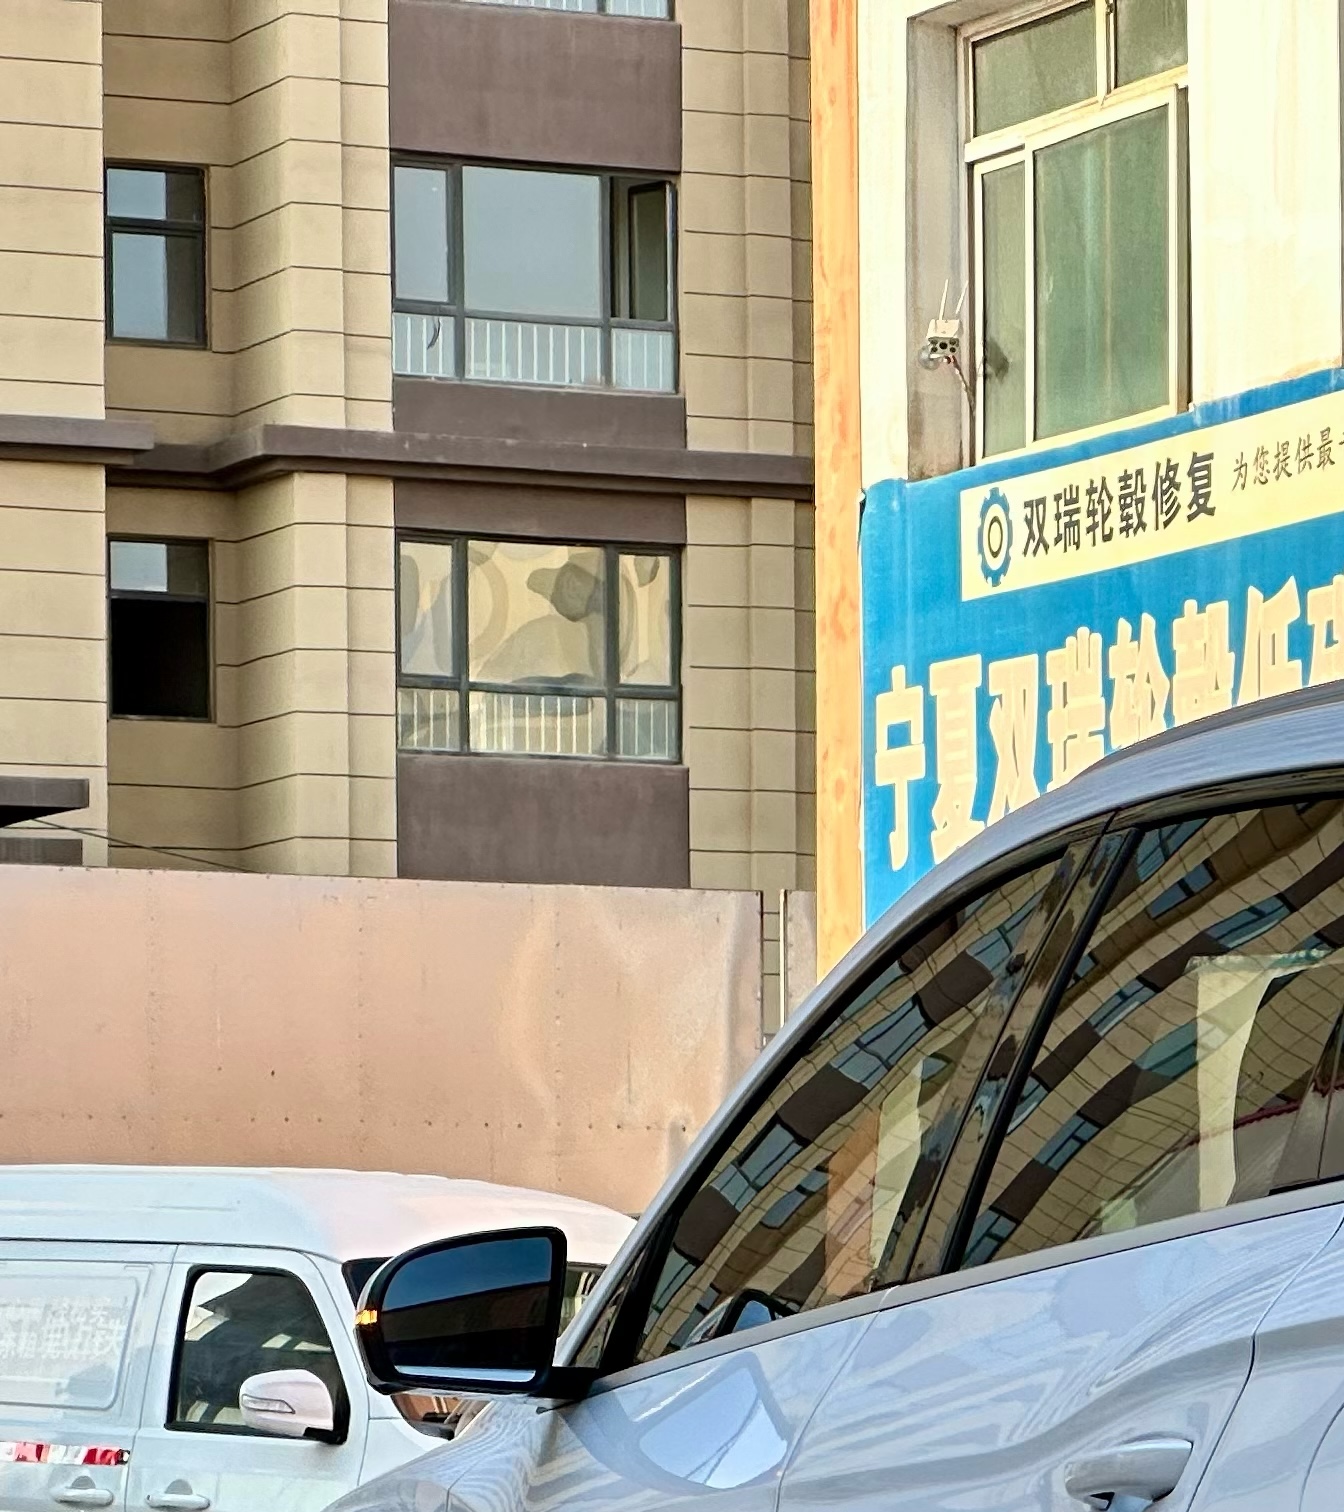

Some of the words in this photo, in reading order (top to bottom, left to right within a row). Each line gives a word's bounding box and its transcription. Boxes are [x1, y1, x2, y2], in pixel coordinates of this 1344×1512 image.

[1021, 450, 1218, 558] 双瑞轮毂修复
